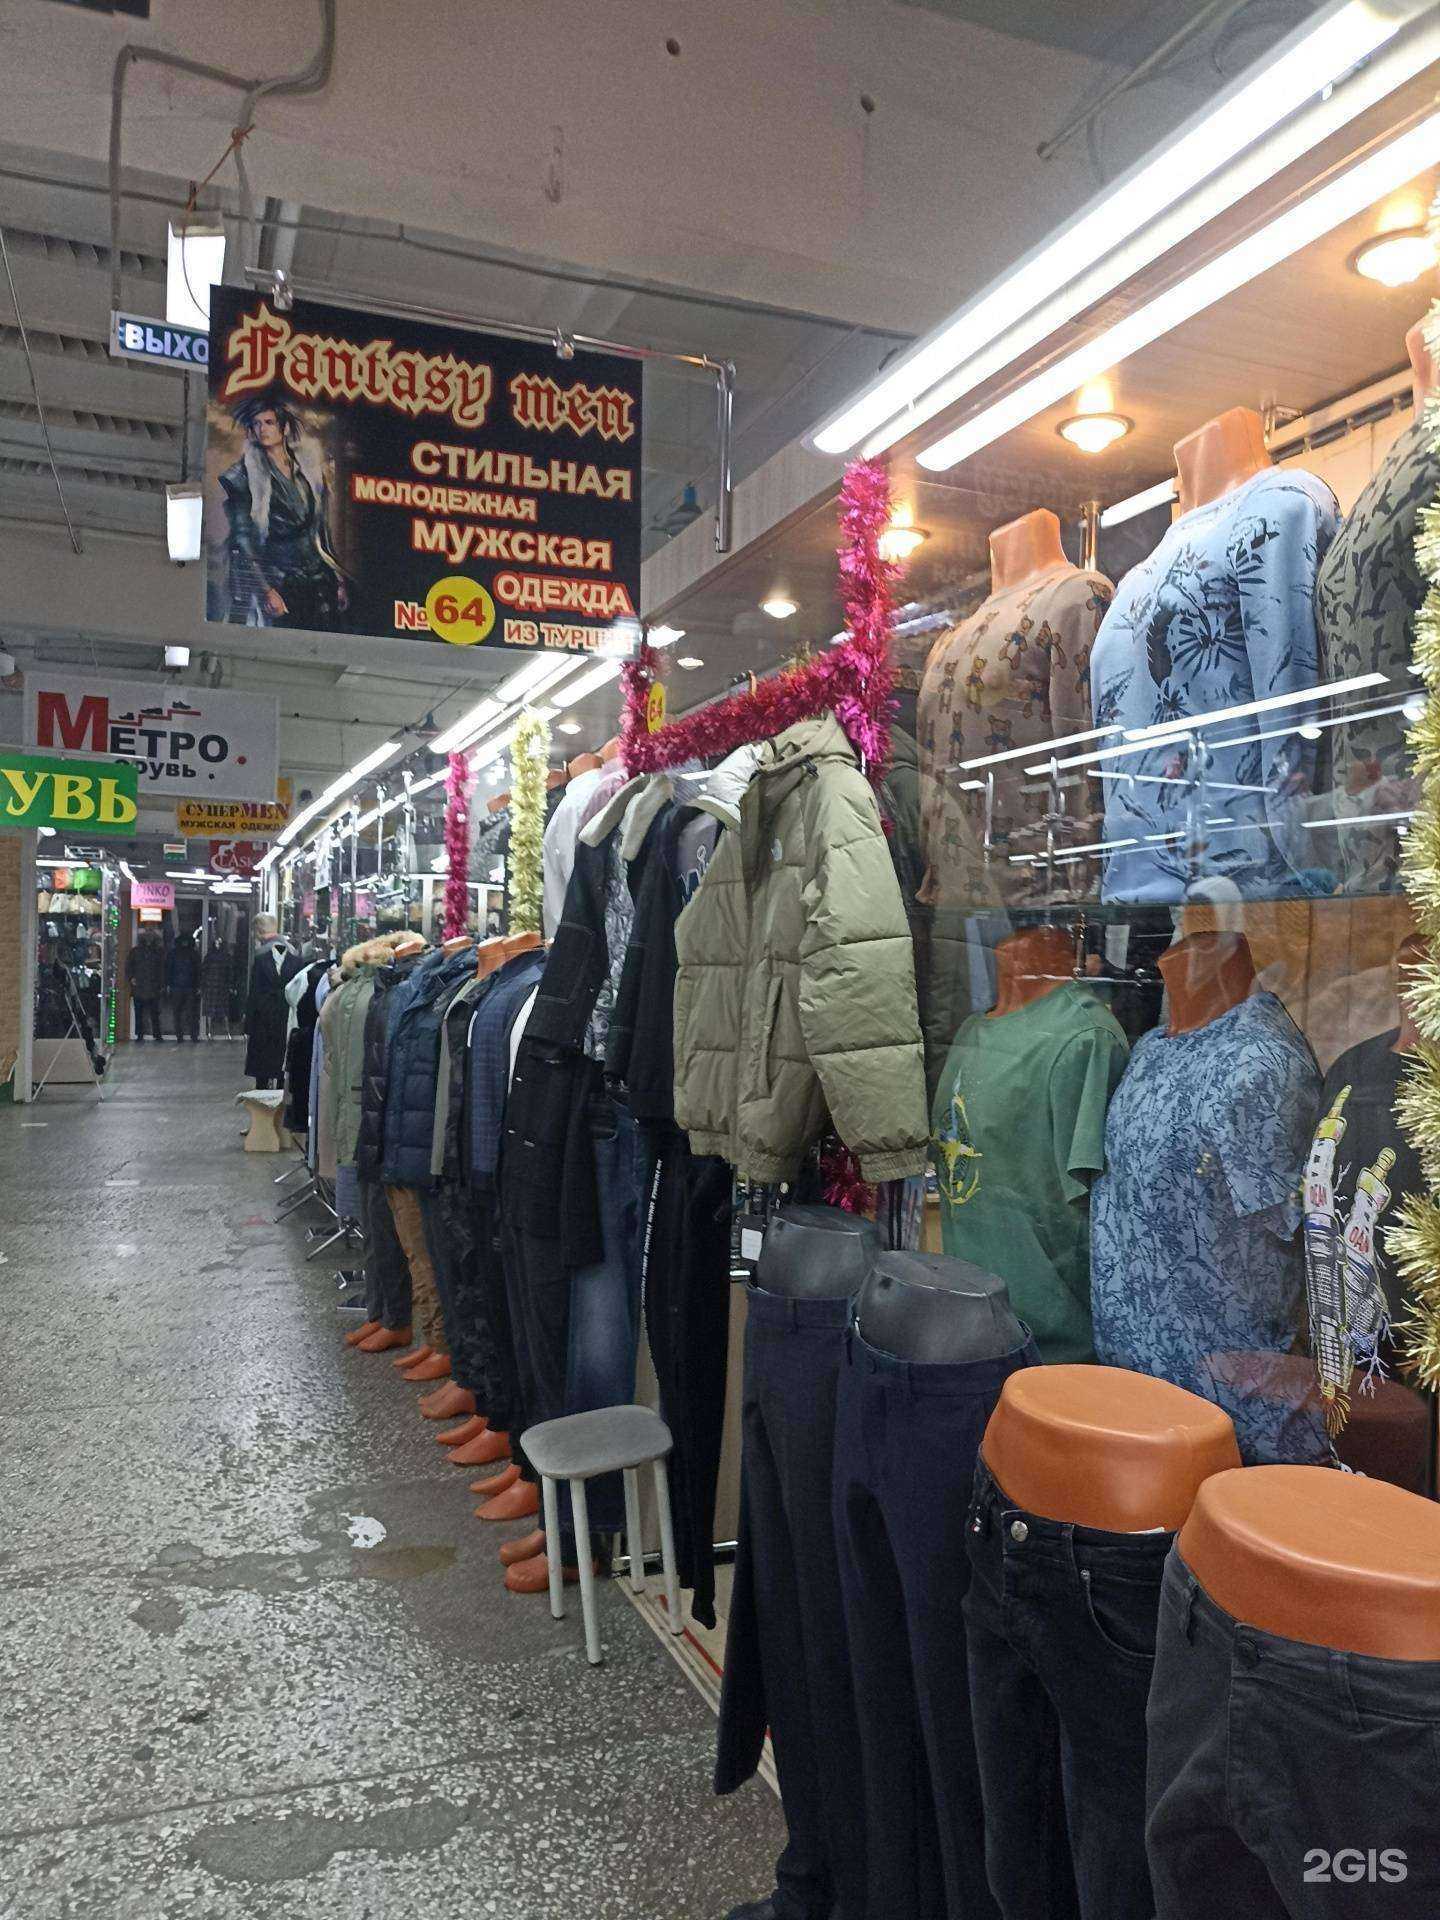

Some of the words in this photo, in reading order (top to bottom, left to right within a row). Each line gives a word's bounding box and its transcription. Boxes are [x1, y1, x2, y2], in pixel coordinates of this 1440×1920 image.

[226, 304, 491, 427] Fantasy
[512, 372, 634, 442] men
[412, 442, 632, 500] СТИЛЬНАЯ
[354, 476, 537, 520] МОЛОДЕЖНАЯ
[434, 595, 486, 626] 64
[496, 574, 631, 615] ОДЕЖДА
[504, 619, 537, 644] ИЗ
[541, 623, 634, 655] ТУРЦ
[37, 691, 229, 763] МЕТРО
[1, 769, 137, 823] УВЬ
[180, 820, 235, 829] МУЖСКАЯ
